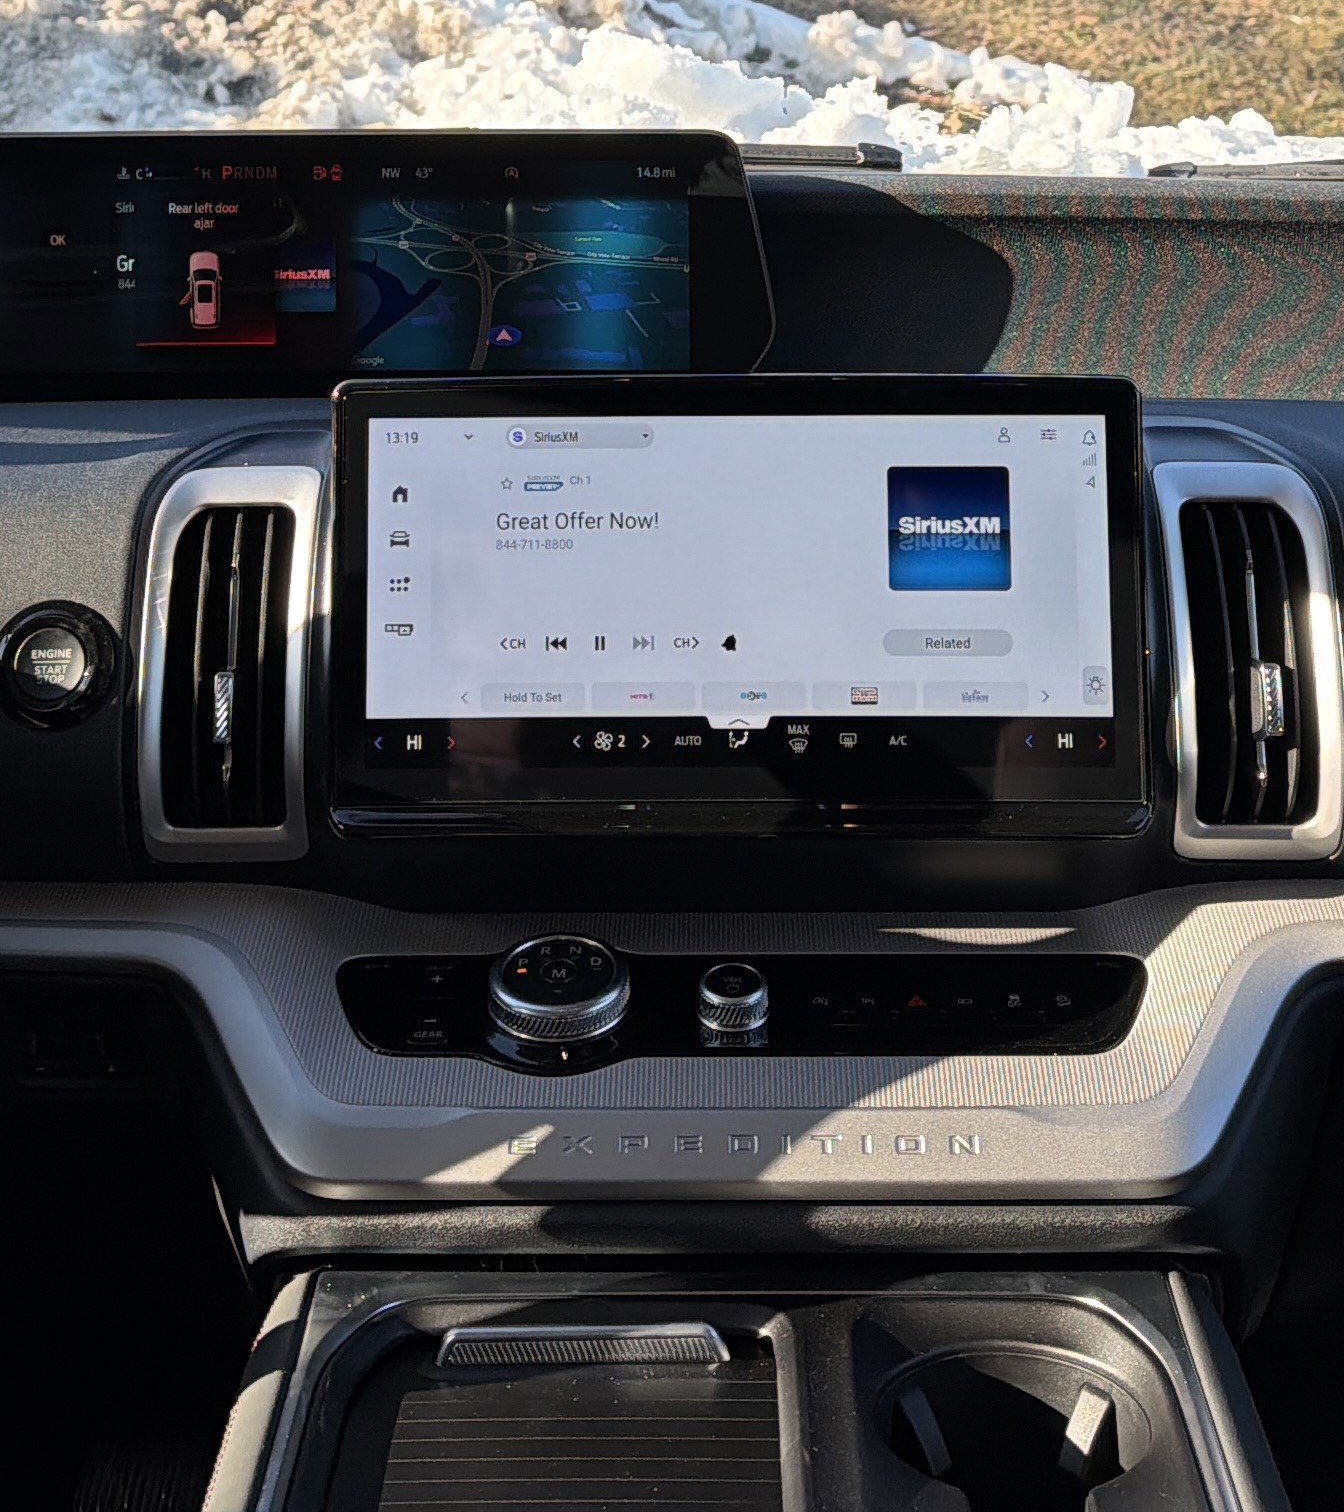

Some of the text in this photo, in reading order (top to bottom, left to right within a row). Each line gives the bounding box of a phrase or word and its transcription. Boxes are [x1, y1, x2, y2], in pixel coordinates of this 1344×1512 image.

[381, 167, 401, 179] NW
[414, 166, 434, 178] 43°
[168, 201, 240, 214] Rear left door
[193, 218, 215, 232] ajar
[49, 234, 67, 246] OK
[353, 354, 385, 367] Google
[385, 431, 419, 444] 13:19
[534, 431, 579, 443] SiriusXM
[569, 475, 584, 485] Ch
[496, 510, 659, 531] Great Offer Now!
[898, 516, 1001, 535] SiriusXM
[496, 538, 574, 551] 844-711-8800
[925, 637, 971, 650] Related
[30, 648, 73, 660] ENGINE
[34, 664, 69, 676] START
[36, 674, 65, 685] STOP
[503, 691, 563, 704] Hold To Set
[787, 724, 810, 736] MAX
[406, 735, 423, 750] HI
[617, 735, 626, 748] 2
[674, 735, 702, 747] AUTO
[888, 735, 908, 747] A/C
[1057, 733, 1074, 749] HI
[540, 946, 552, 956] R
[569, 946, 583, 956] N
[518, 958, 529, 967] P
[590, 956, 603, 966] D
[551, 968, 567, 979] M
[722, 976, 744, 984] VOL
[413, 1030, 444, 1039] GEAR
[508, 1134, 981, 1156] EXPEDITION
